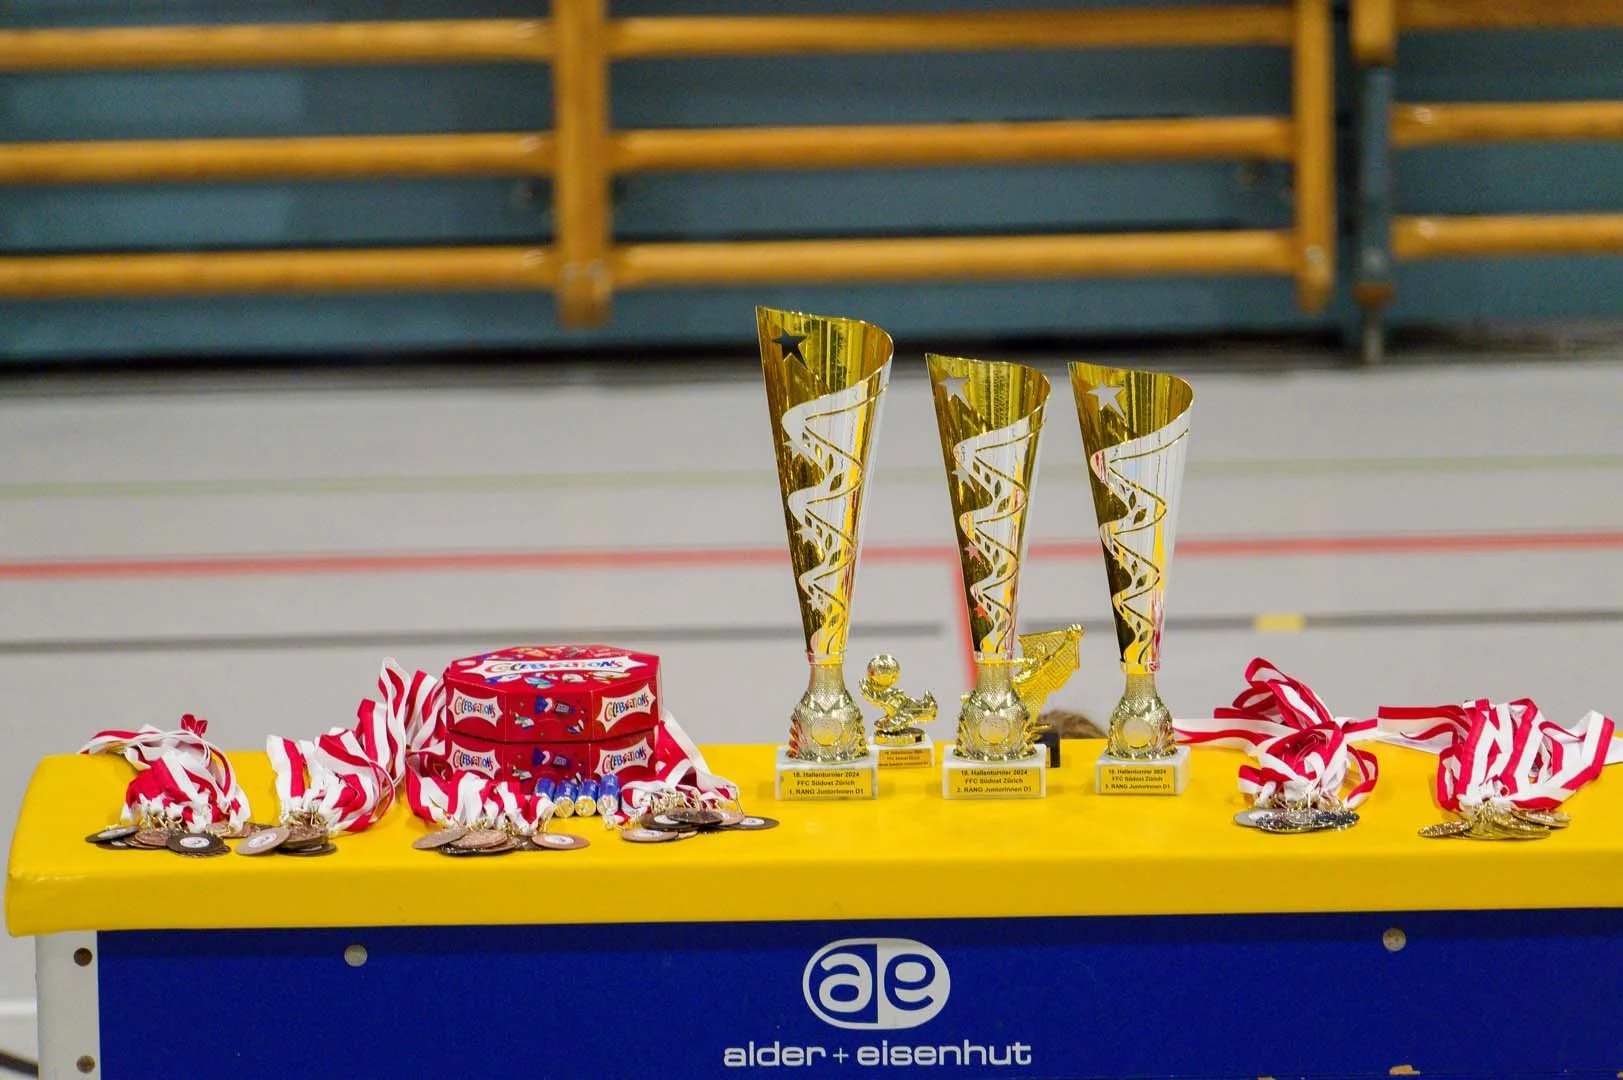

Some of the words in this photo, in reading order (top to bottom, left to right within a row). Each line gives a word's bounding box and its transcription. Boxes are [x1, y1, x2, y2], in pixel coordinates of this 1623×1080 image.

[724, 1041, 826, 1067] alder
[832, 1047, 849, 1064] +
[857, 1039, 1032, 1067] eisenhut
